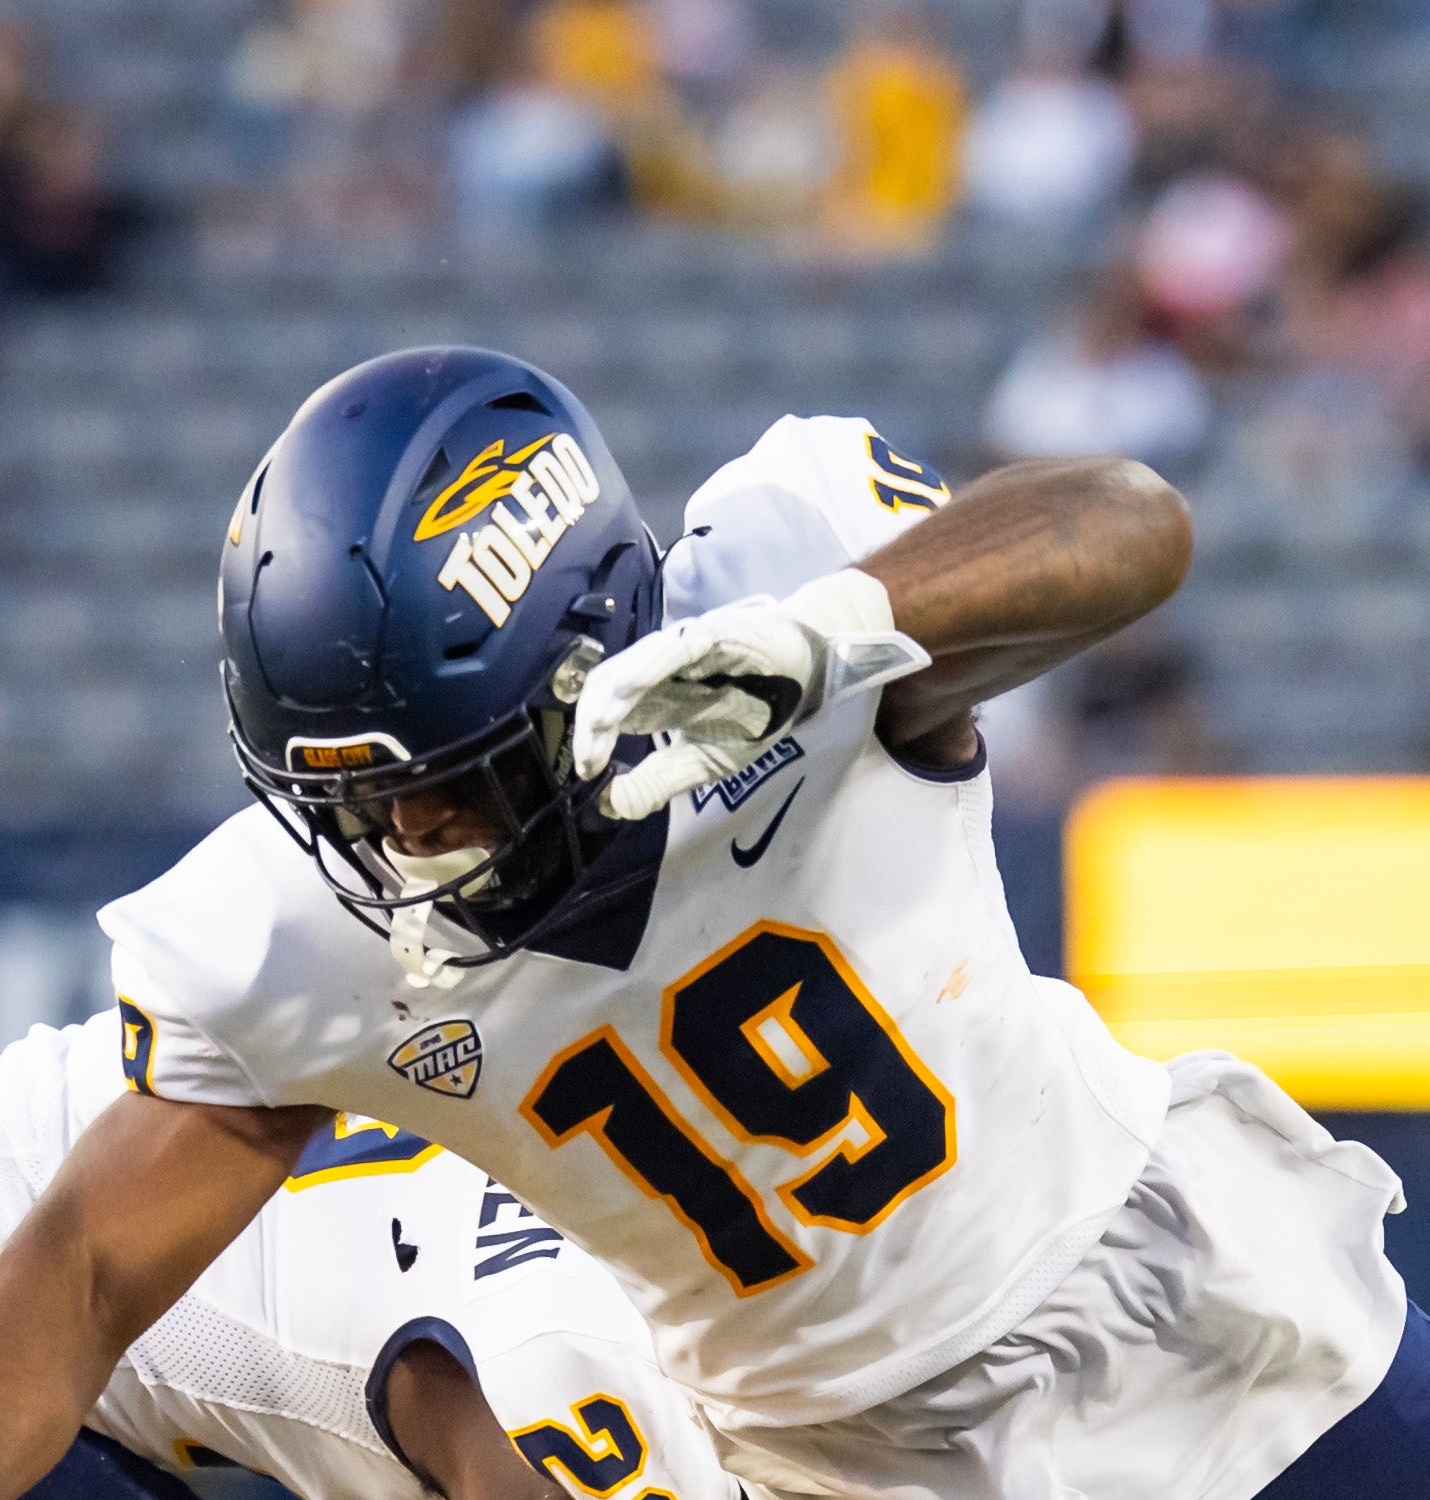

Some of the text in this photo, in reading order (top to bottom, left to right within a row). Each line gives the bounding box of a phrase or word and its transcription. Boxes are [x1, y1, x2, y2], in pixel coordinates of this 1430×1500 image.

[437, 433, 600, 628] TOLEDO
[405, 1036, 482, 1083] MAC
[518, 918, 957, 1298] 19
